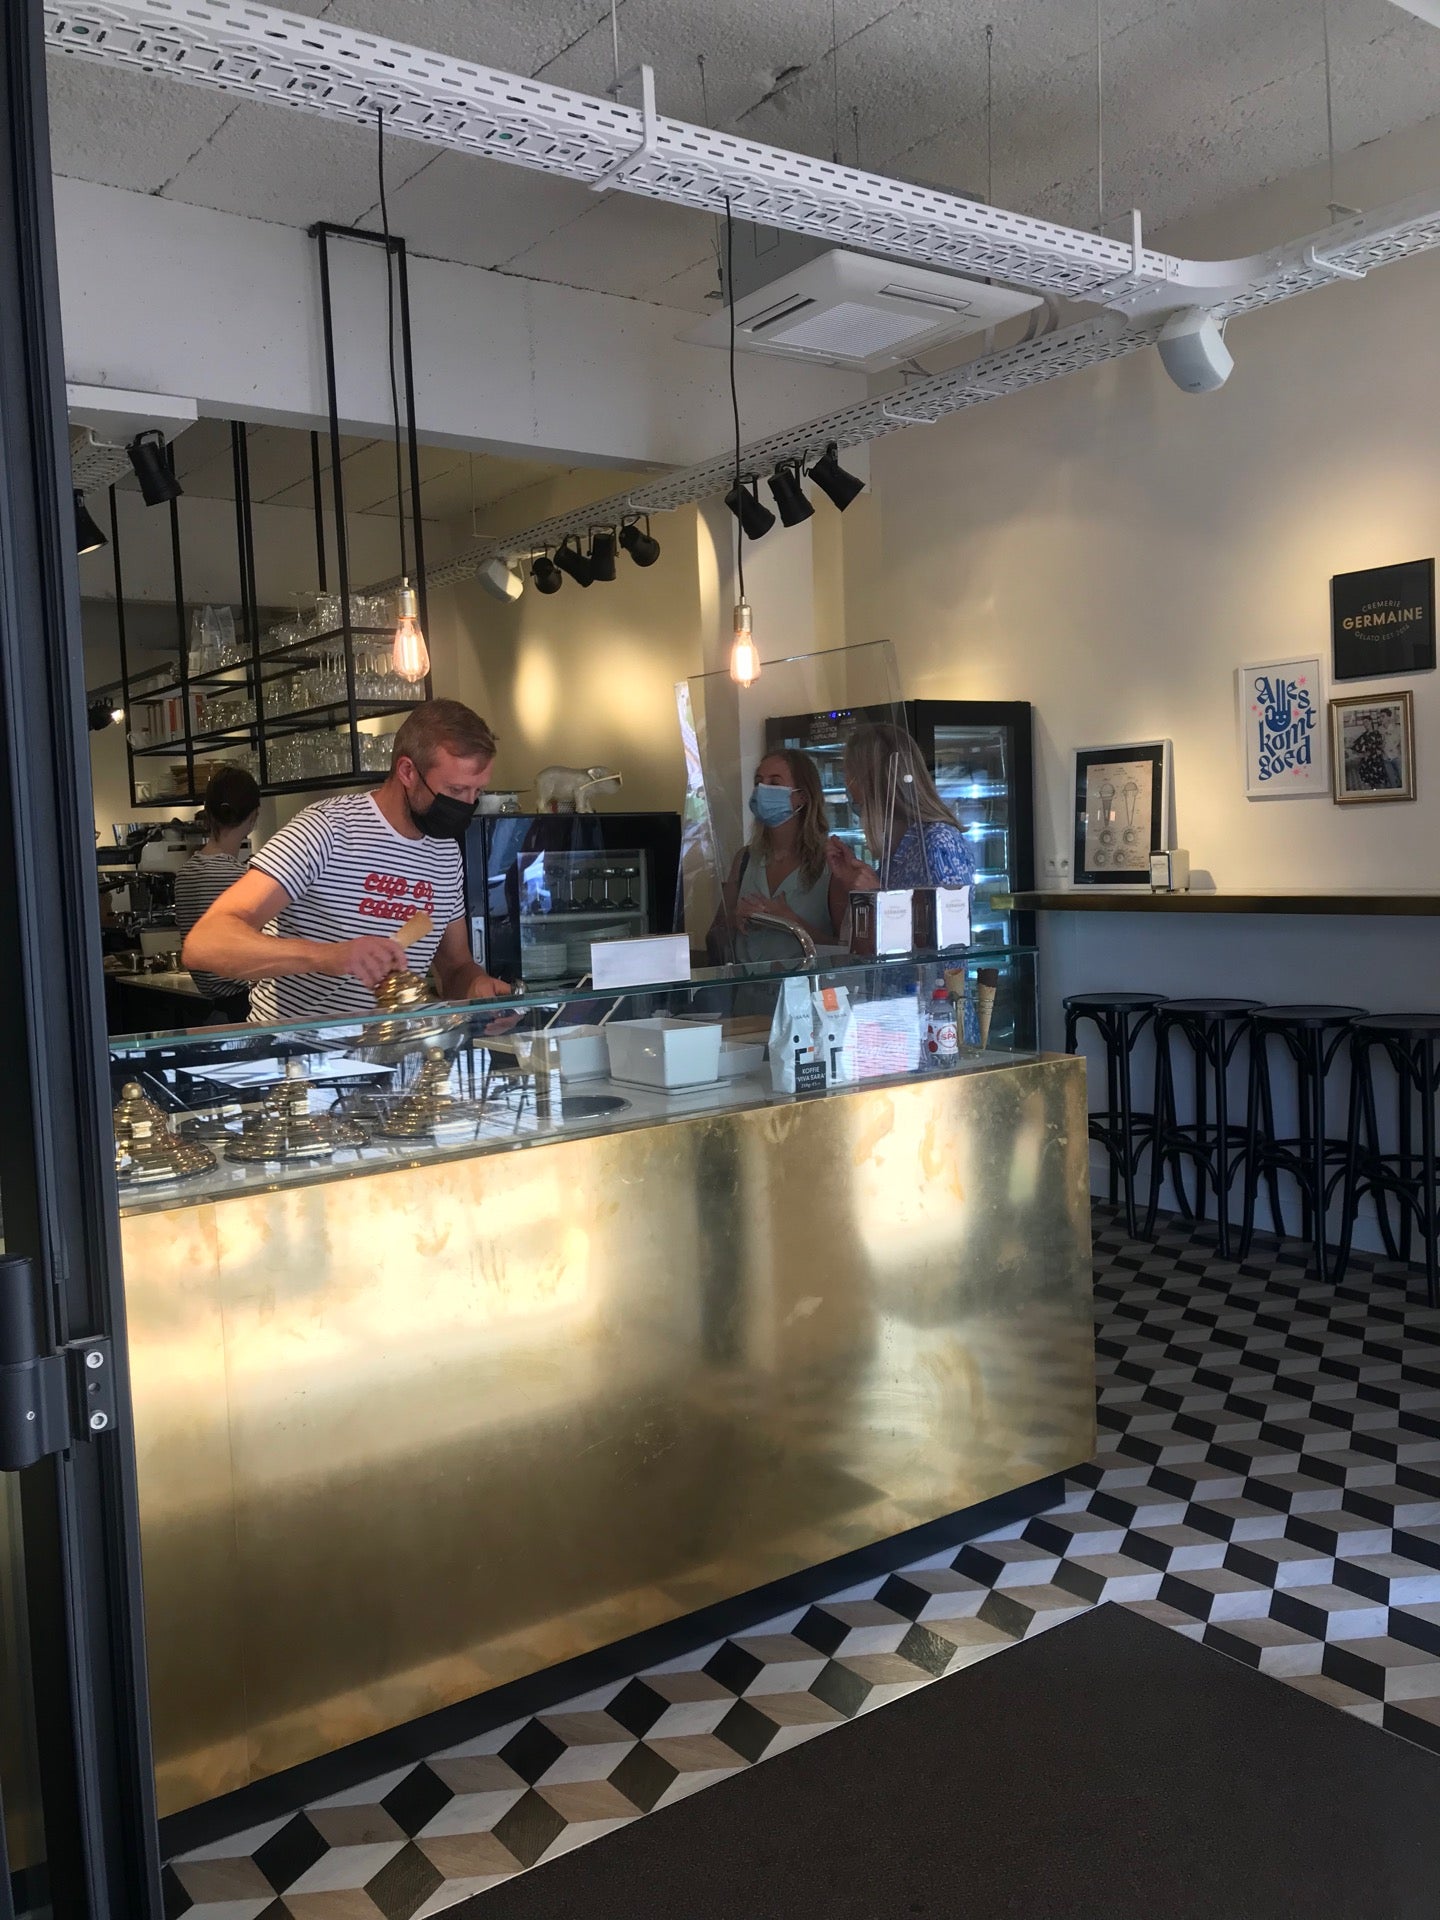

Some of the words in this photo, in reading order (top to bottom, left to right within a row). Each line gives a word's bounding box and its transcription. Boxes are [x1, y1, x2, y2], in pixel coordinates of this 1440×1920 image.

[1342, 606, 1424, 630] GERMAINE
[1354, 630, 1381, 642] GELATO
[1254, 676, 1311, 710] Alles
[1258, 706, 1317, 758] komt
[1258, 734, 1312, 781] goed
[941, 1033, 956, 1041] SPA
[801, 1066, 820, 1075] KOFFIE
